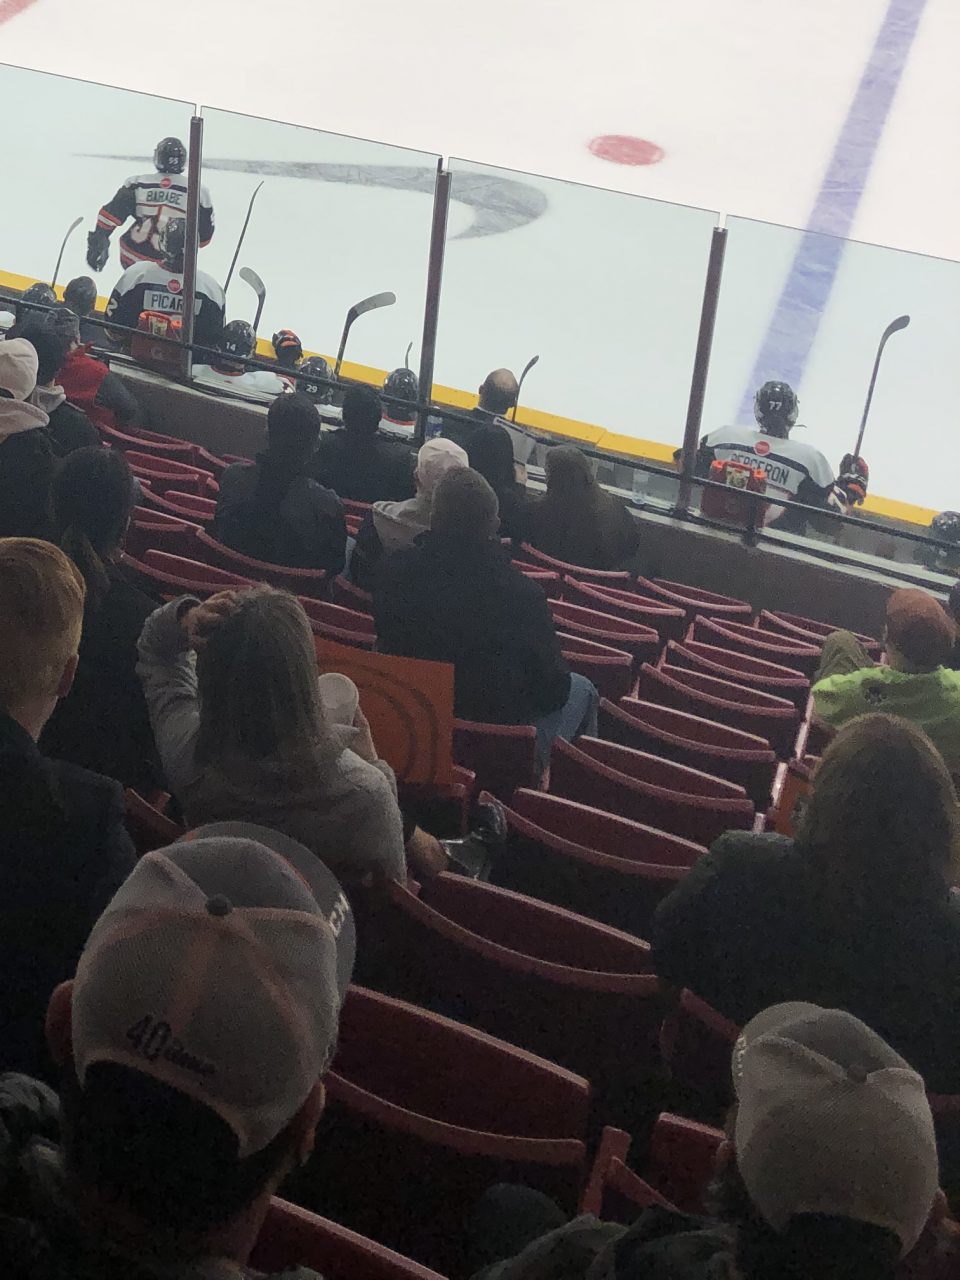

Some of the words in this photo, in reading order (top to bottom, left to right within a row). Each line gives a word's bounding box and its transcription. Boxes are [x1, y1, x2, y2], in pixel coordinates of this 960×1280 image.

[150, 293, 184, 311] PICAR
[226, 341, 236, 351] 14
[305, 382, 319, 394] 29
[768, 400, 783, 411] 77
